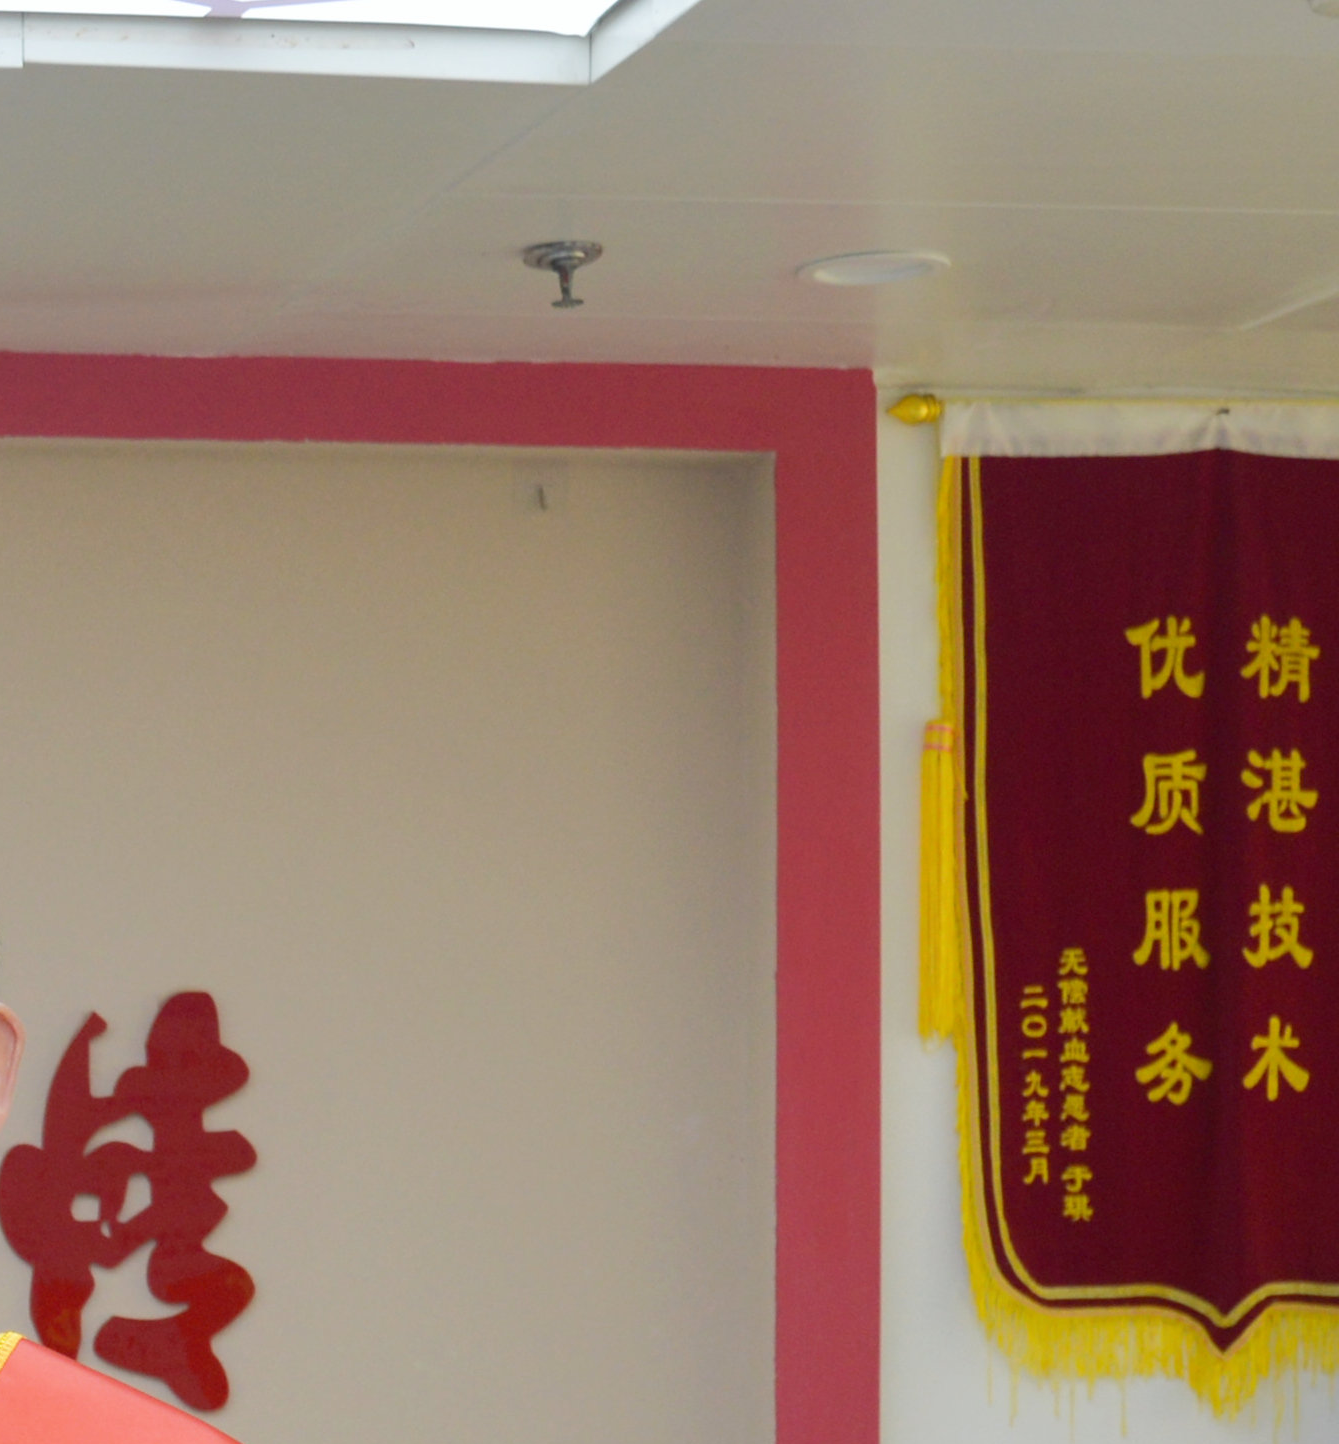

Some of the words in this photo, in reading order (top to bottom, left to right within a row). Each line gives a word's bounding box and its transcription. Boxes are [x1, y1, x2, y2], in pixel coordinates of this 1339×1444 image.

[1125, 616, 1212, 1106] 优质服务
[1240, 614, 1320, 1102] 精湛技术
